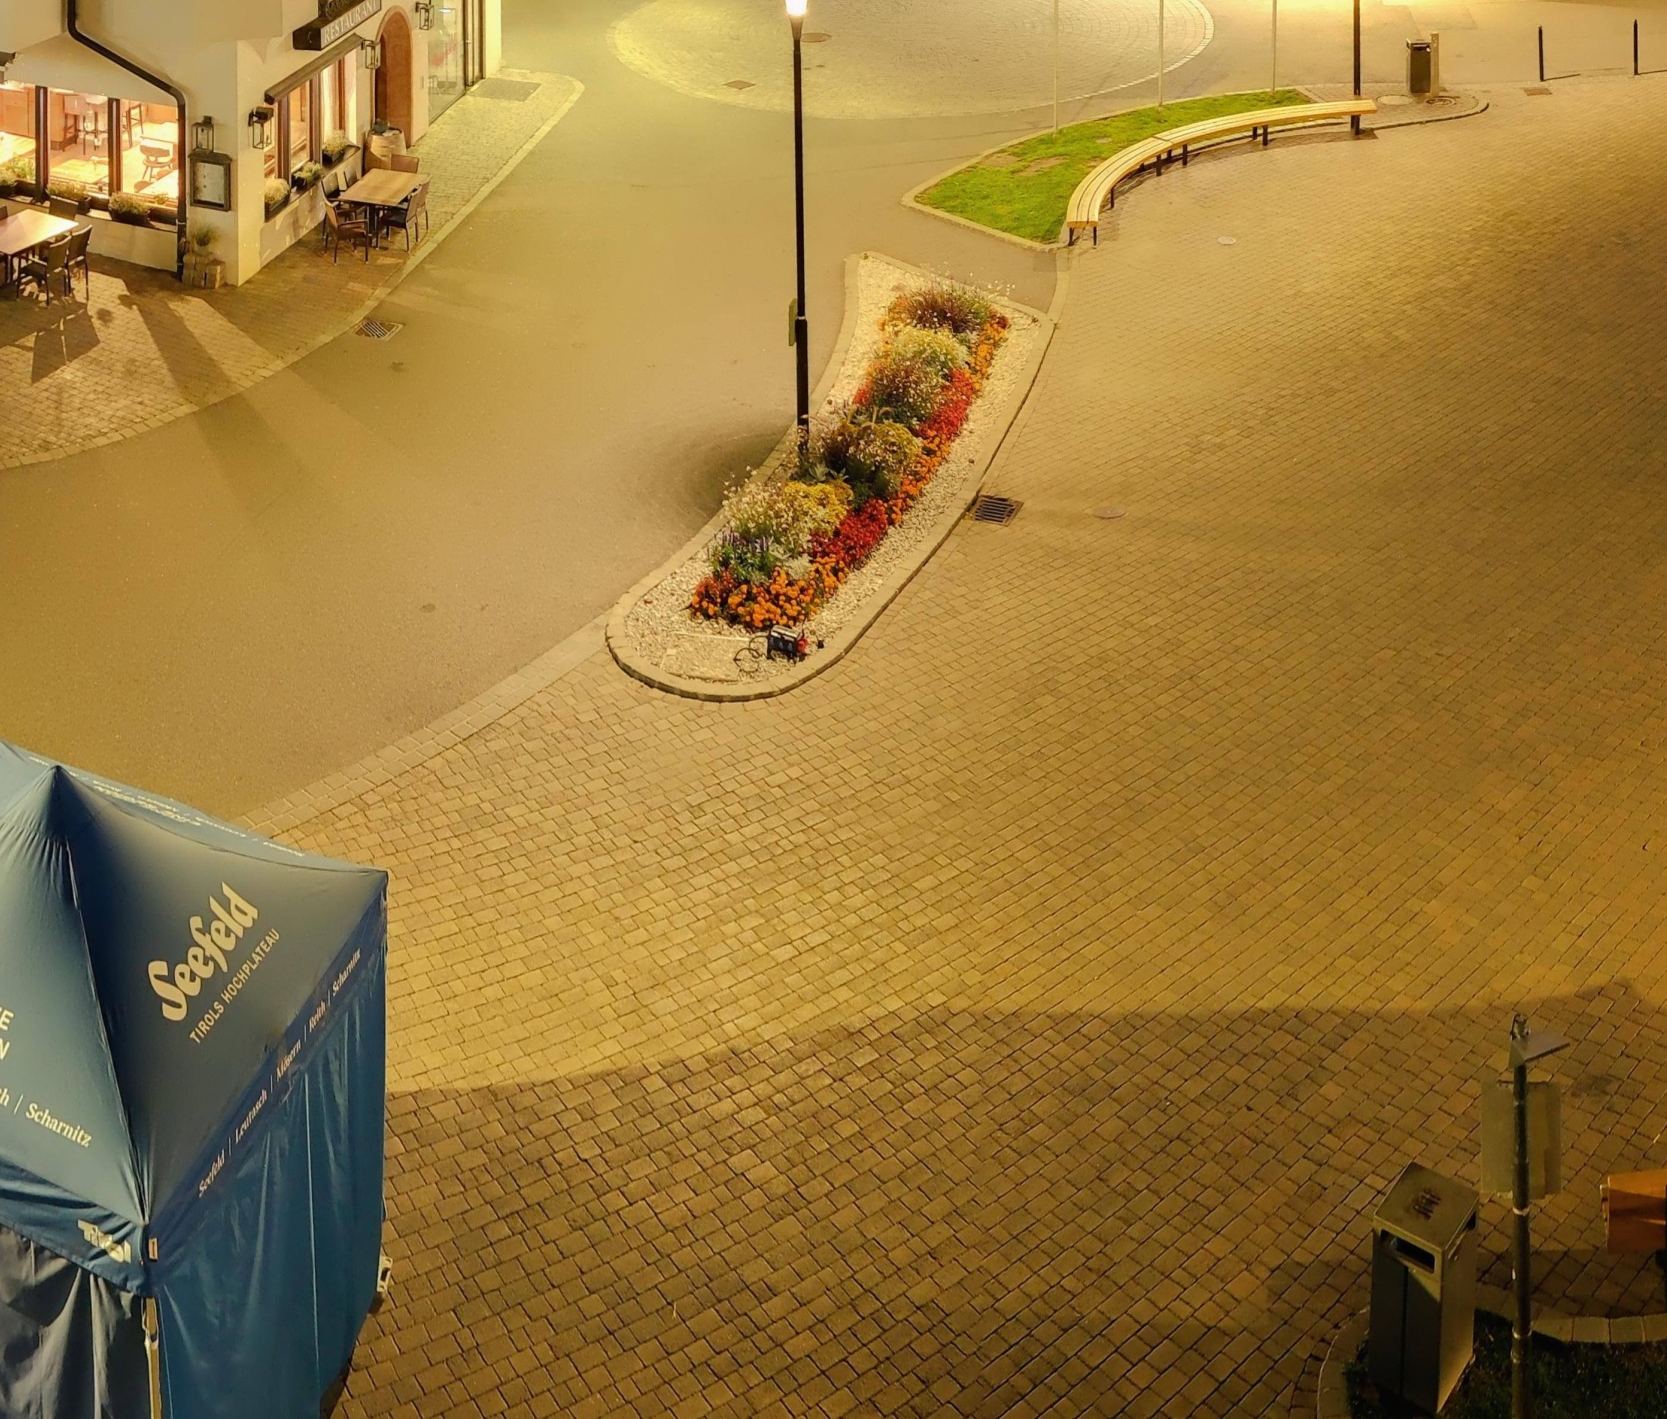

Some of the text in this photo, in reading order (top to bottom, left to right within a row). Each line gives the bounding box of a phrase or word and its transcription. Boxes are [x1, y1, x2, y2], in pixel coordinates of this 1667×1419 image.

[147, 881, 259, 1022] Seefeld
[189, 928, 281, 1045] TIROLS HOCHPLATEAU
[25, 1102, 93, 1149] Scharnitz
